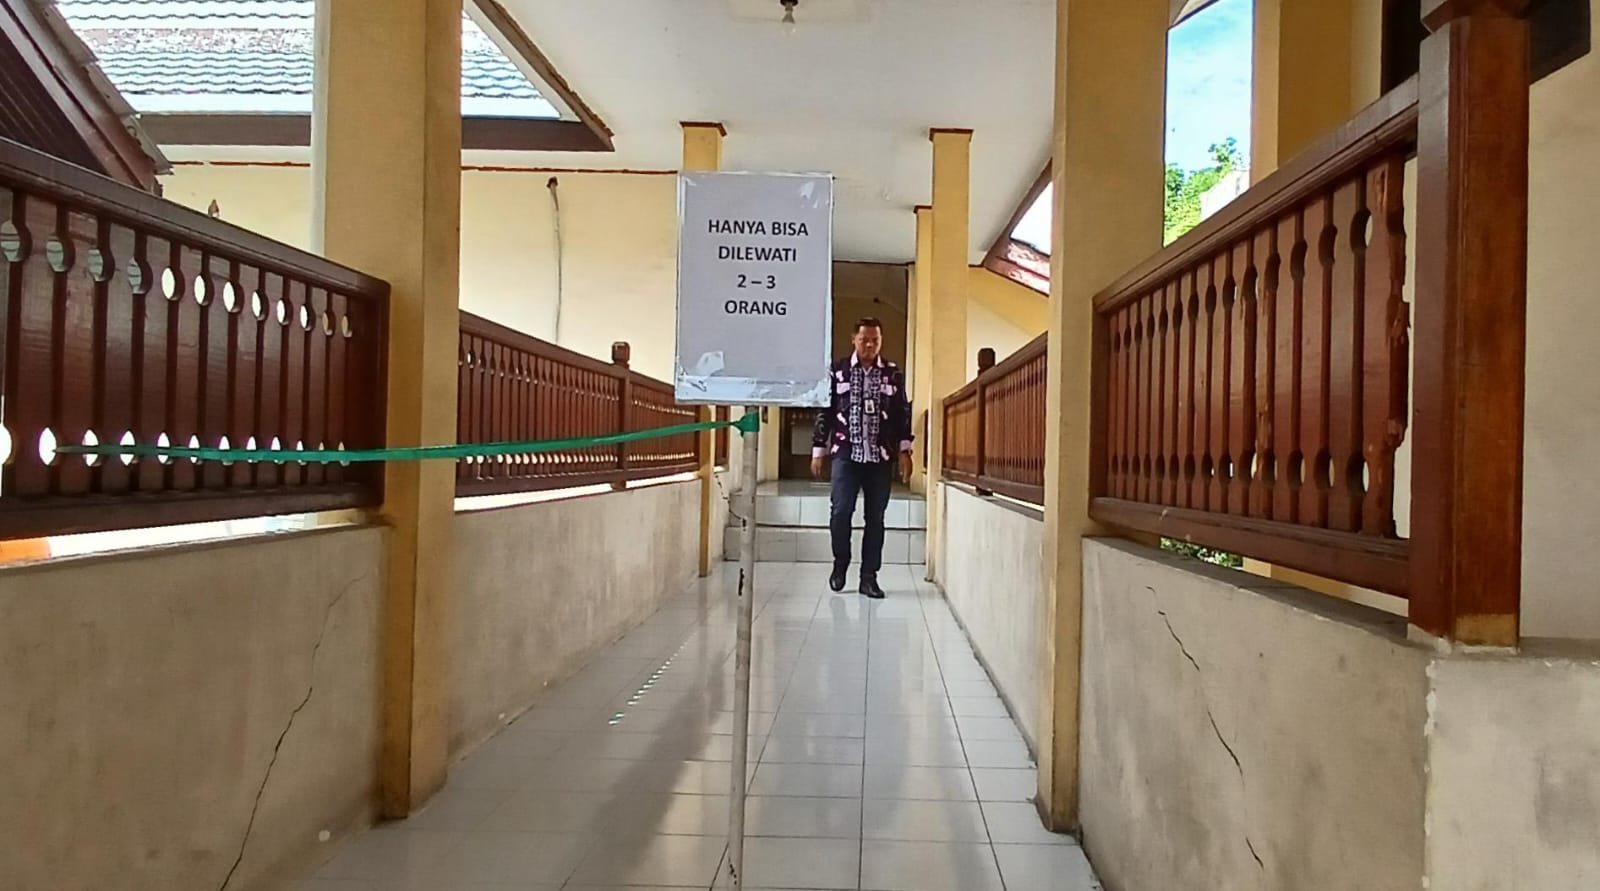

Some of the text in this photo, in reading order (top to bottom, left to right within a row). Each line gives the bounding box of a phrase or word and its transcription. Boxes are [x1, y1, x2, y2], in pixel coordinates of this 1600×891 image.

[708, 218, 809, 237] HANYA BISA
[718, 245, 797, 262] DILEWATI
[737, 273, 747, 289] 2
[766, 274, 776, 290] 3
[724, 299, 787, 316] ORANG
